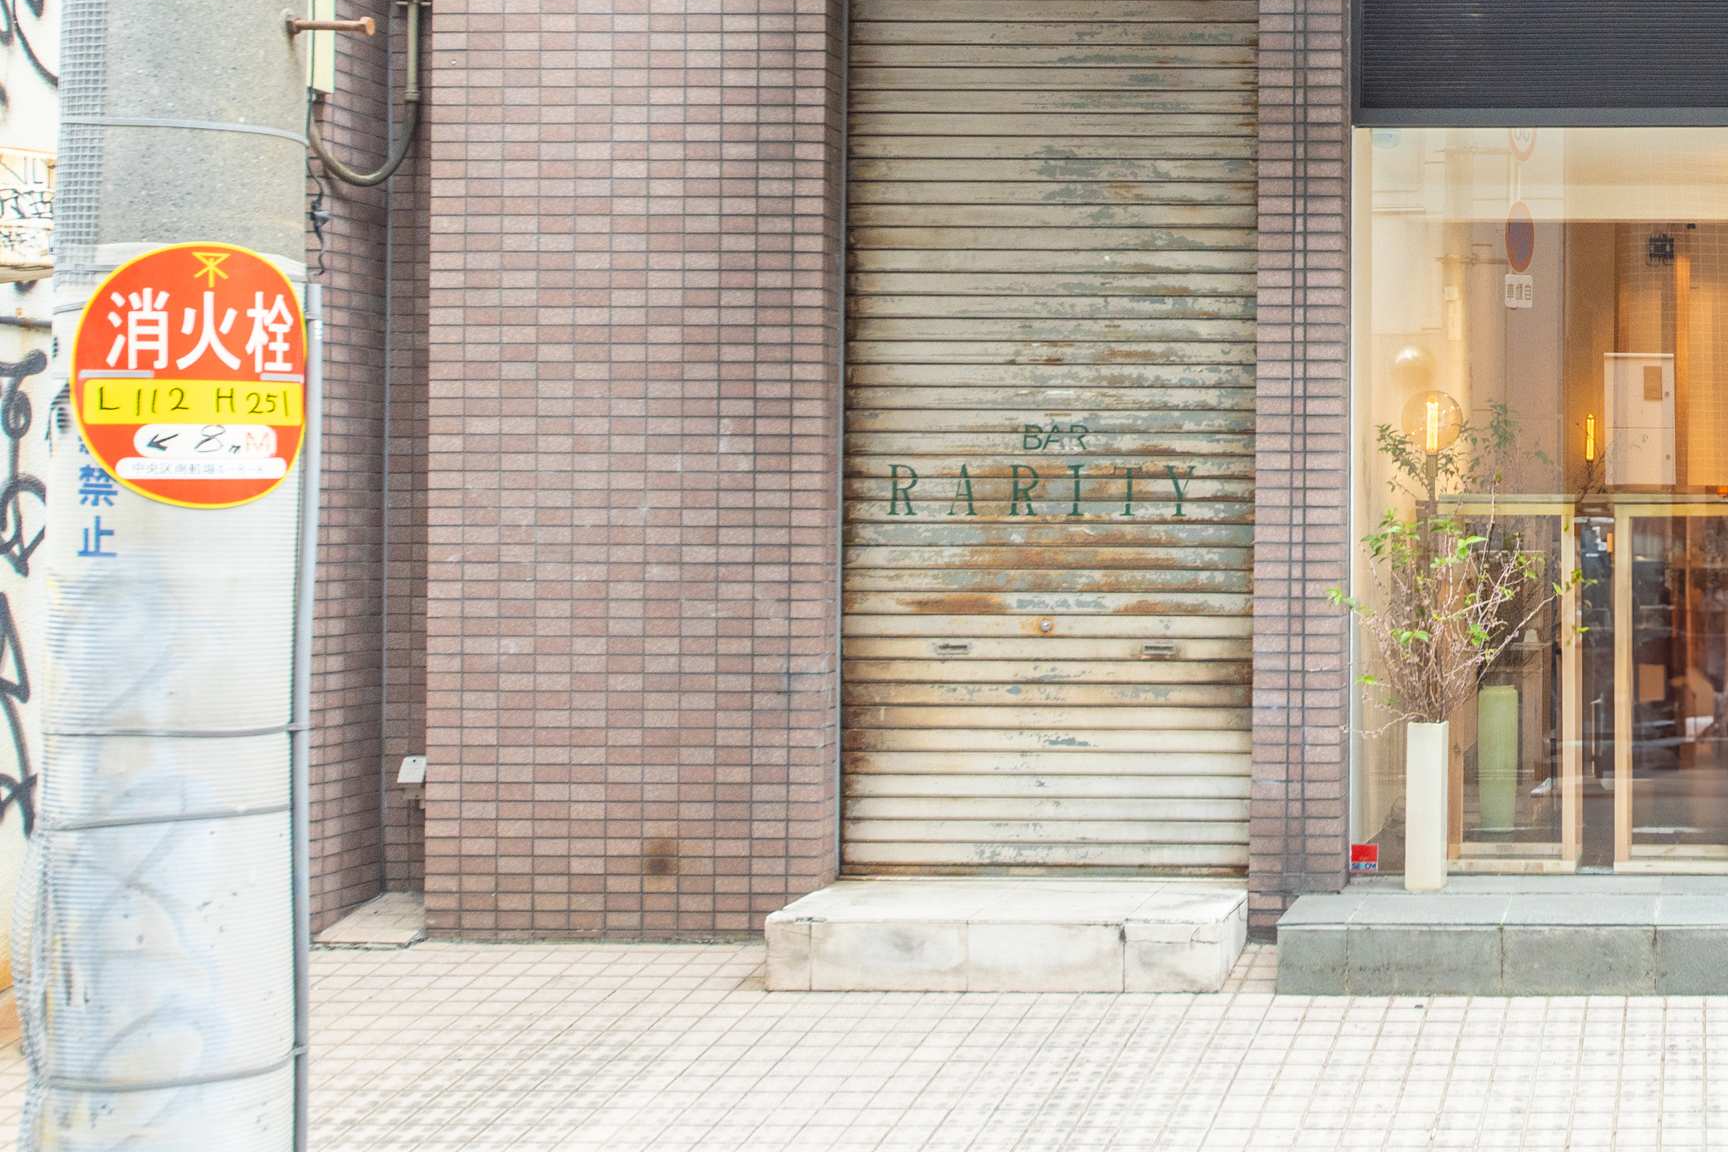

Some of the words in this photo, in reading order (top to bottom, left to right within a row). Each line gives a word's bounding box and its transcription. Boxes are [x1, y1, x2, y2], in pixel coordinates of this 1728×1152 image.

[106, 287, 294, 372] 消火栓
[1022, 425, 1089, 450] BAR
[886, 463, 1197, 517] RARITY
